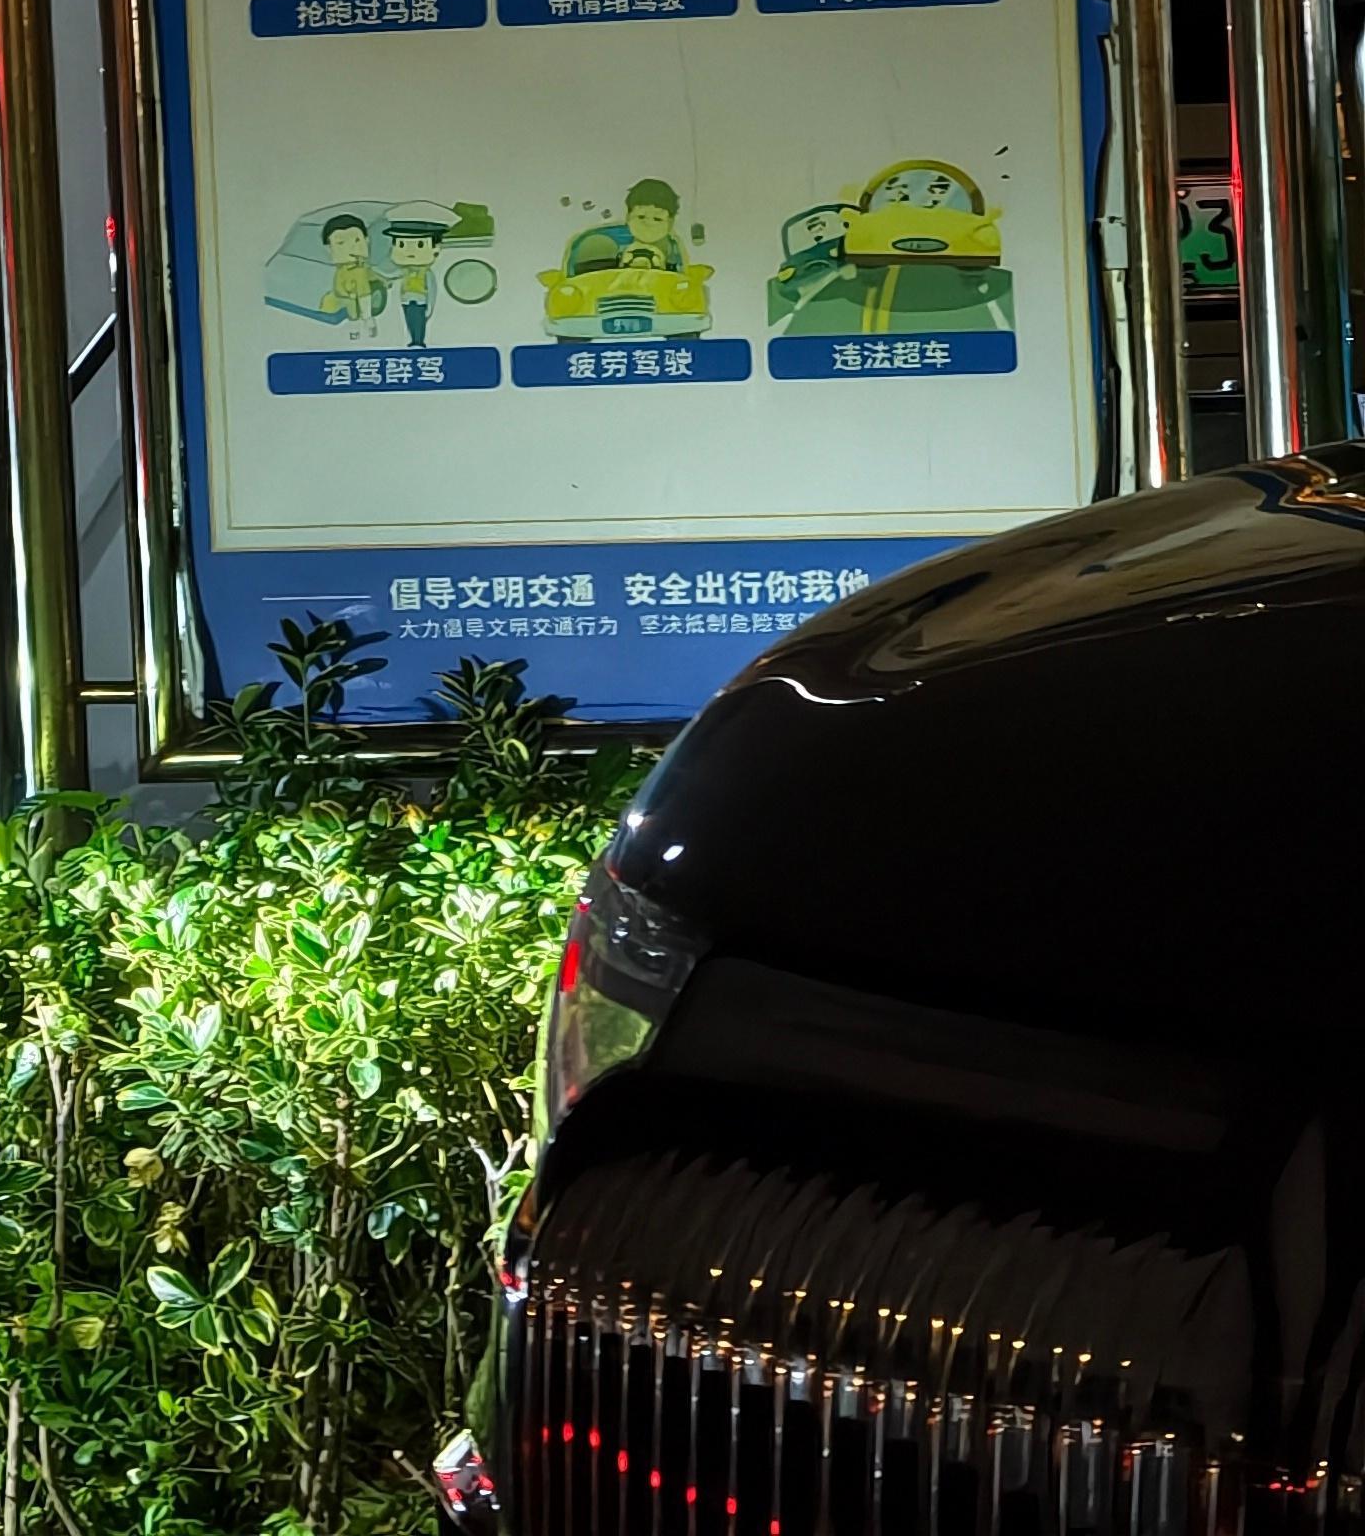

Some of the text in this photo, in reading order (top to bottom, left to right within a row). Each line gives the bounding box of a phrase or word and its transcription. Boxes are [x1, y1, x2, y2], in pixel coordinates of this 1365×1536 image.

[322, 356, 445, 387] 酒驾醉驾
[566, 347, 694, 379] 疲劳驾驶
[831, 341, 953, 372] 违法超车
[389, 573, 596, 611] 倡导文明交通
